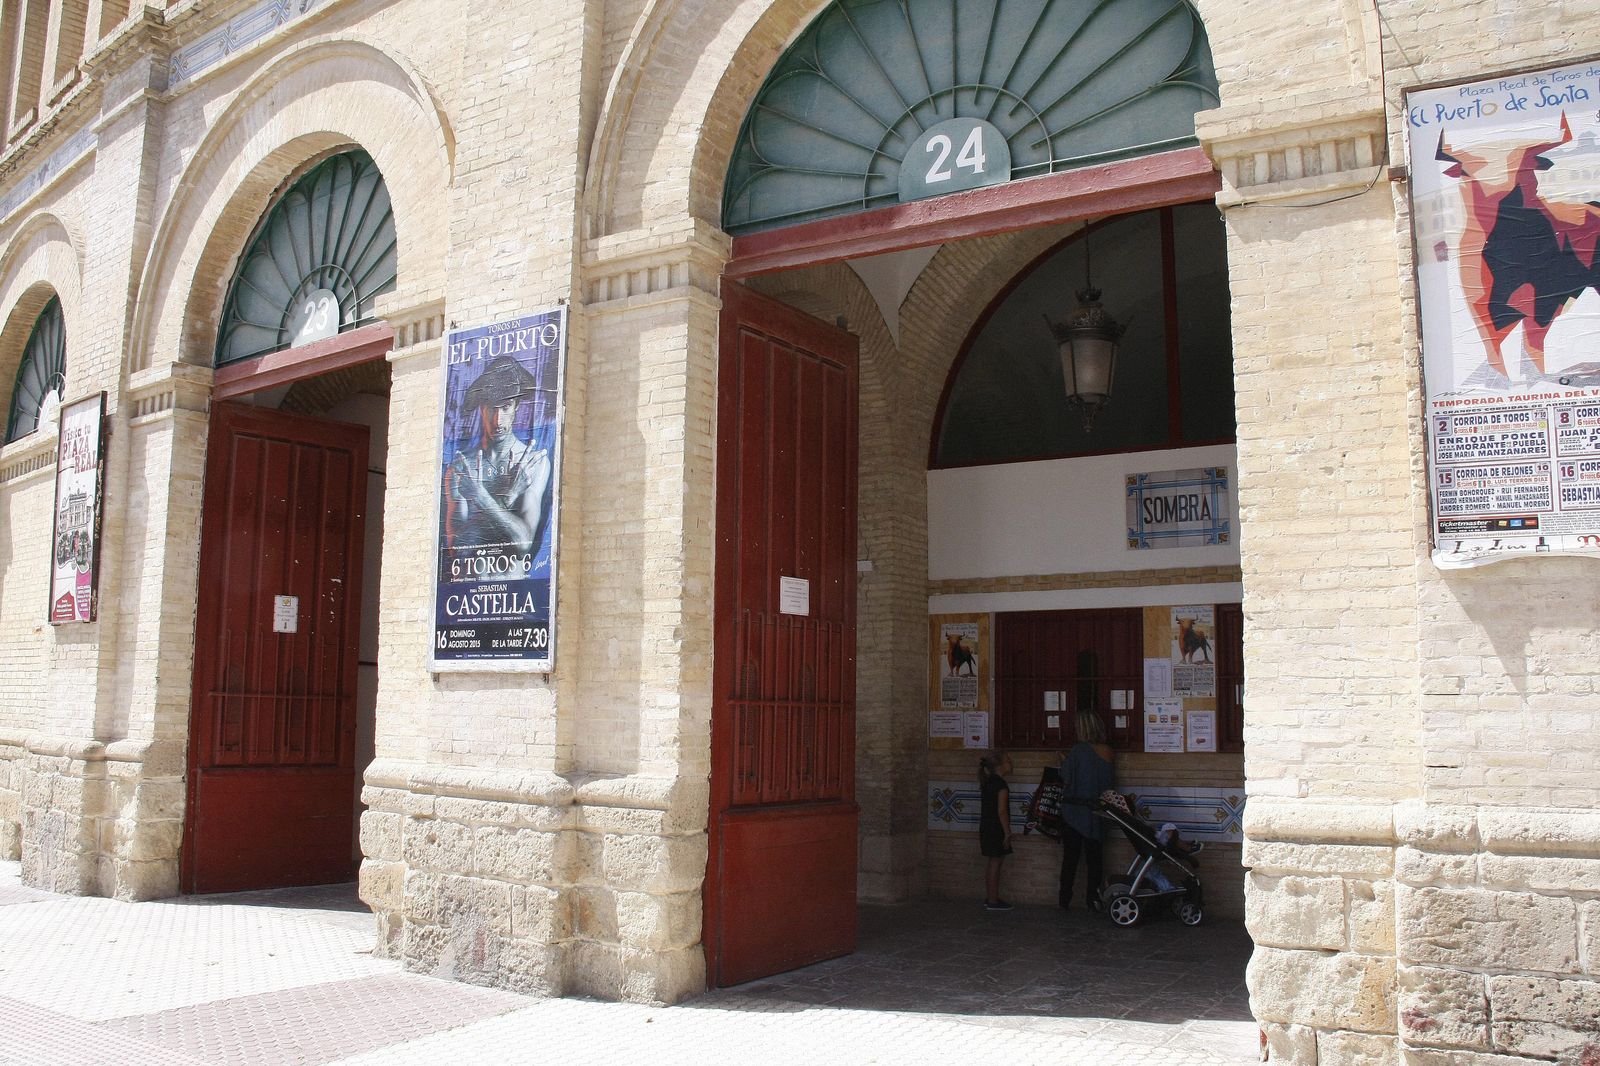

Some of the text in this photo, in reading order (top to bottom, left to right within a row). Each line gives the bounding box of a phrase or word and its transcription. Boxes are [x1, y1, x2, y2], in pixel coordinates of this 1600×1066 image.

[1459, 87, 1495, 98] Plaza
[1499, 77, 1528, 92] Real
[1532, 74, 1547, 86] de
[1549, 71, 1581, 83] Toros
[1504, 92, 1527, 112] de
[1534, 84, 1590, 109] Santa
[925, 126, 986, 184] 24
[304, 296, 330, 336] 23
[487, 319, 521, 334] TOROS EN
[449, 323, 558, 366] EL PUERTO
[1432, 396, 1504, 408] TEMPORADA
[1507, 392, 1561, 403] TAURINA
[1565, 390, 1588, 398] DEL
[1453, 415, 1489, 426] CORRIDA
[1491, 414, 1501, 424] DE
[1503, 412, 1530, 423] TOROS
[1560, 412, 1570, 423] 8
[1577, 418, 1583, 426] 6
[1438, 421, 1447, 432] 2
[1560, 428, 1587, 437] JUAN
[1438, 434, 1496, 445] ENRIQUE
[1501, 431, 1545, 441] PONCE
[1512, 439, 1547, 448] PUEBLA
[62, 435, 90, 461] PLAZA
[1438, 446, 1547, 459] JOSE MARIA MANZANARES
[1456, 441, 1506, 451] MORANTE
[74, 450, 97, 475] REAL
[1456, 465, 1533, 479] CORRIDA DE REJONES
[1560, 465, 1575, 477] 16
[1438, 472, 1453, 484] 15
[1514, 485, 1550, 494] FERNANDES
[1495, 494, 1513, 502] MANUEL
[1514, 492, 1550, 501] MANZANARES
[1143, 492, 1212, 525] SOMBRA
[1464, 503, 1491, 511] ROMERO
[1497, 501, 1522, 509] MANUEL
[1523, 499, 1550, 508] MORENO
[1439, 520, 1486, 528] ticketmaster
[451, 558, 461, 576] 6
[464, 554, 518, 575] TOROS
[522, 553, 532, 572] 6
[446, 591, 536, 616] CASTELLA
[449, 629, 476, 638] DOMINGO
[508, 628, 523, 637] A LAS
[436, 630, 448, 649] 16
[448, 639, 481, 649] AGOSTO 2015
[491, 639, 523, 648] DE LA TARDE
